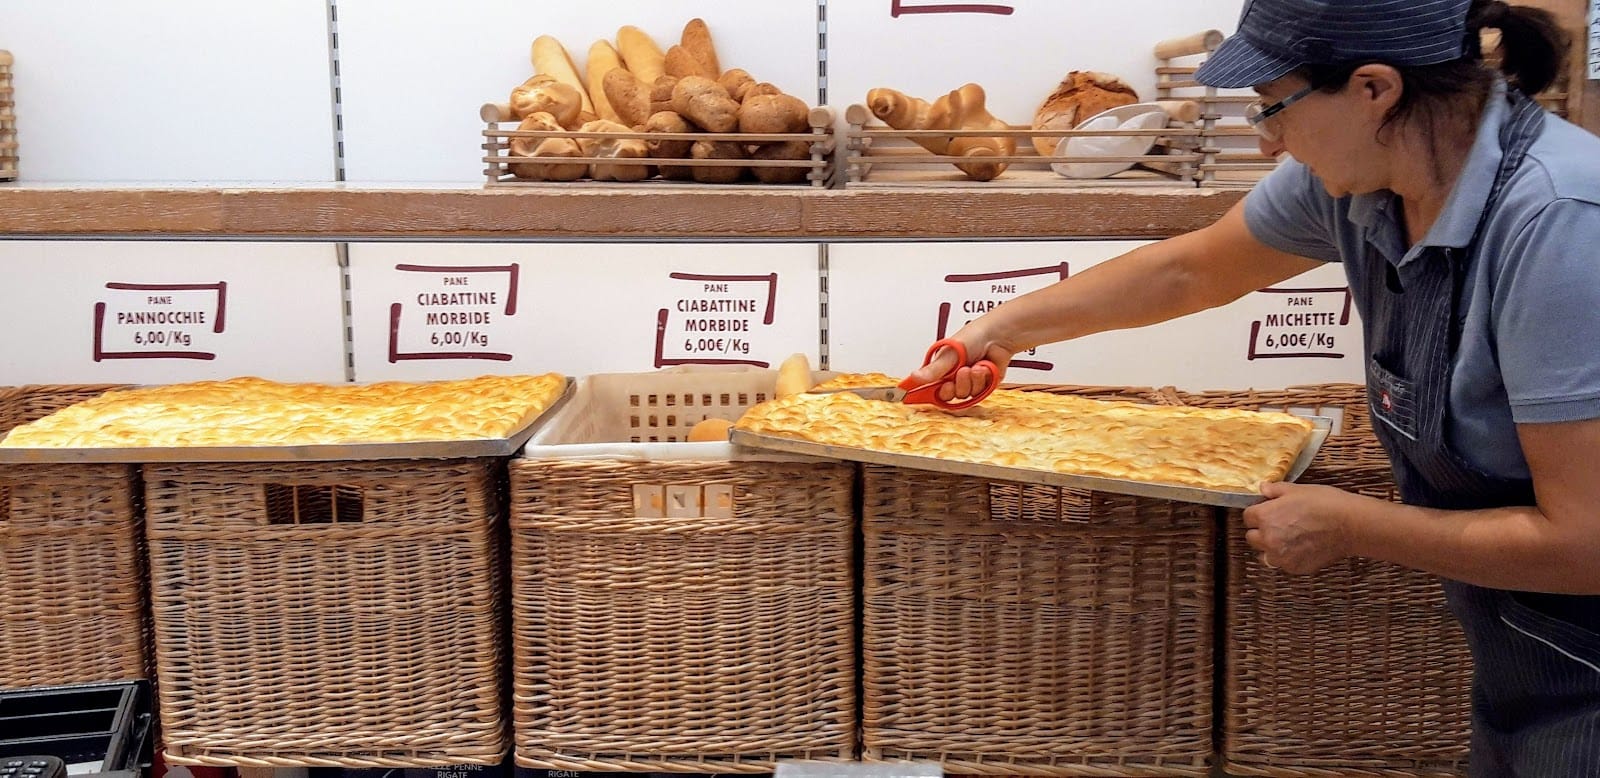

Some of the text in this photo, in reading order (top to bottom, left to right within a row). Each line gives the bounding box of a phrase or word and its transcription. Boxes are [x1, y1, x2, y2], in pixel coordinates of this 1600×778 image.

[443, 276, 468, 286] PANE
[704, 283, 729, 293] PANE
[991, 284, 1016, 294] PANE
[147, 295, 172, 305] PANE
[417, 291, 497, 306] CIABATTINE
[1287, 296, 1314, 306] PANE
[677, 299, 756, 313] CIABATTINE
[117, 311, 206, 325] PANNOCCHIE
[426, 311, 491, 326] MORBIDE
[685, 318, 749, 332] MORBIDE
[1265, 312, 1336, 327] MICHETTE
[134, 330, 191, 346] 6,00/Kg
[430, 331, 488, 347] 6,00/Kg
[1265, 332, 1335, 349] 6,00€/Kg
[684, 338, 750, 354] 6,00€/Kg
[548, 770, 580, 778] RIGATE
